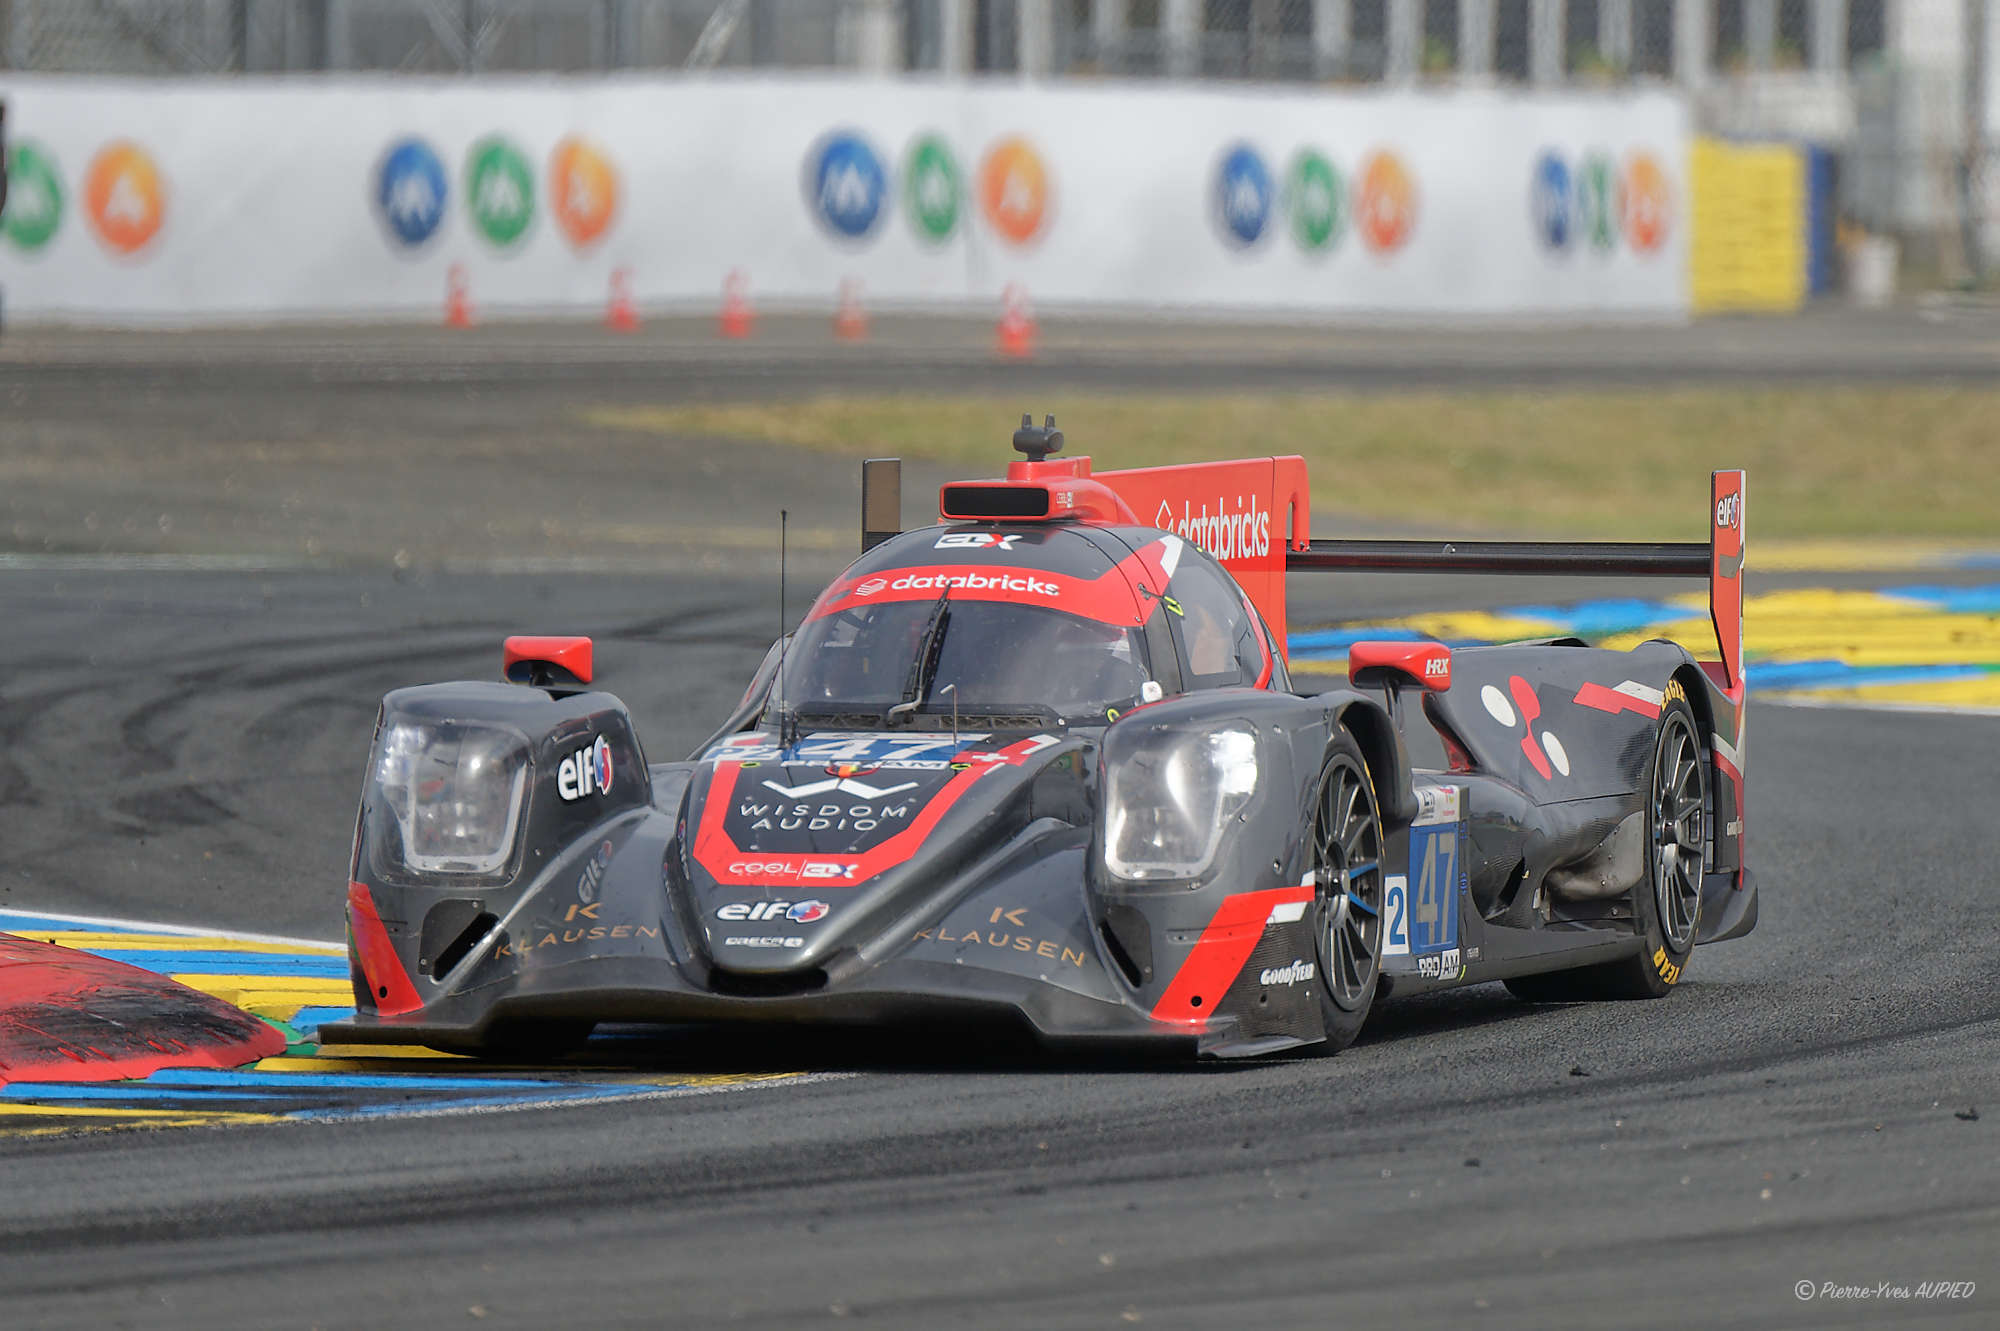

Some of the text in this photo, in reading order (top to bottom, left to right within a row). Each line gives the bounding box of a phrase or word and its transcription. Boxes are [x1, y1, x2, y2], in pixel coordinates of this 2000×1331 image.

[891, 573, 1060, 596] databricks
[1425, 659, 1449, 675] HRX
[797, 739, 958, 759] 47
[557, 745, 596, 800] elf
[740, 804, 908, 818] WISDOM
[750, 818, 879, 831] AUDIO
[1416, 832, 1456, 945] 47
[716, 902, 791, 920] elf
[494, 925, 659, 960] KLAUSEN
[912, 929, 1085, 967] KLAUSEN
